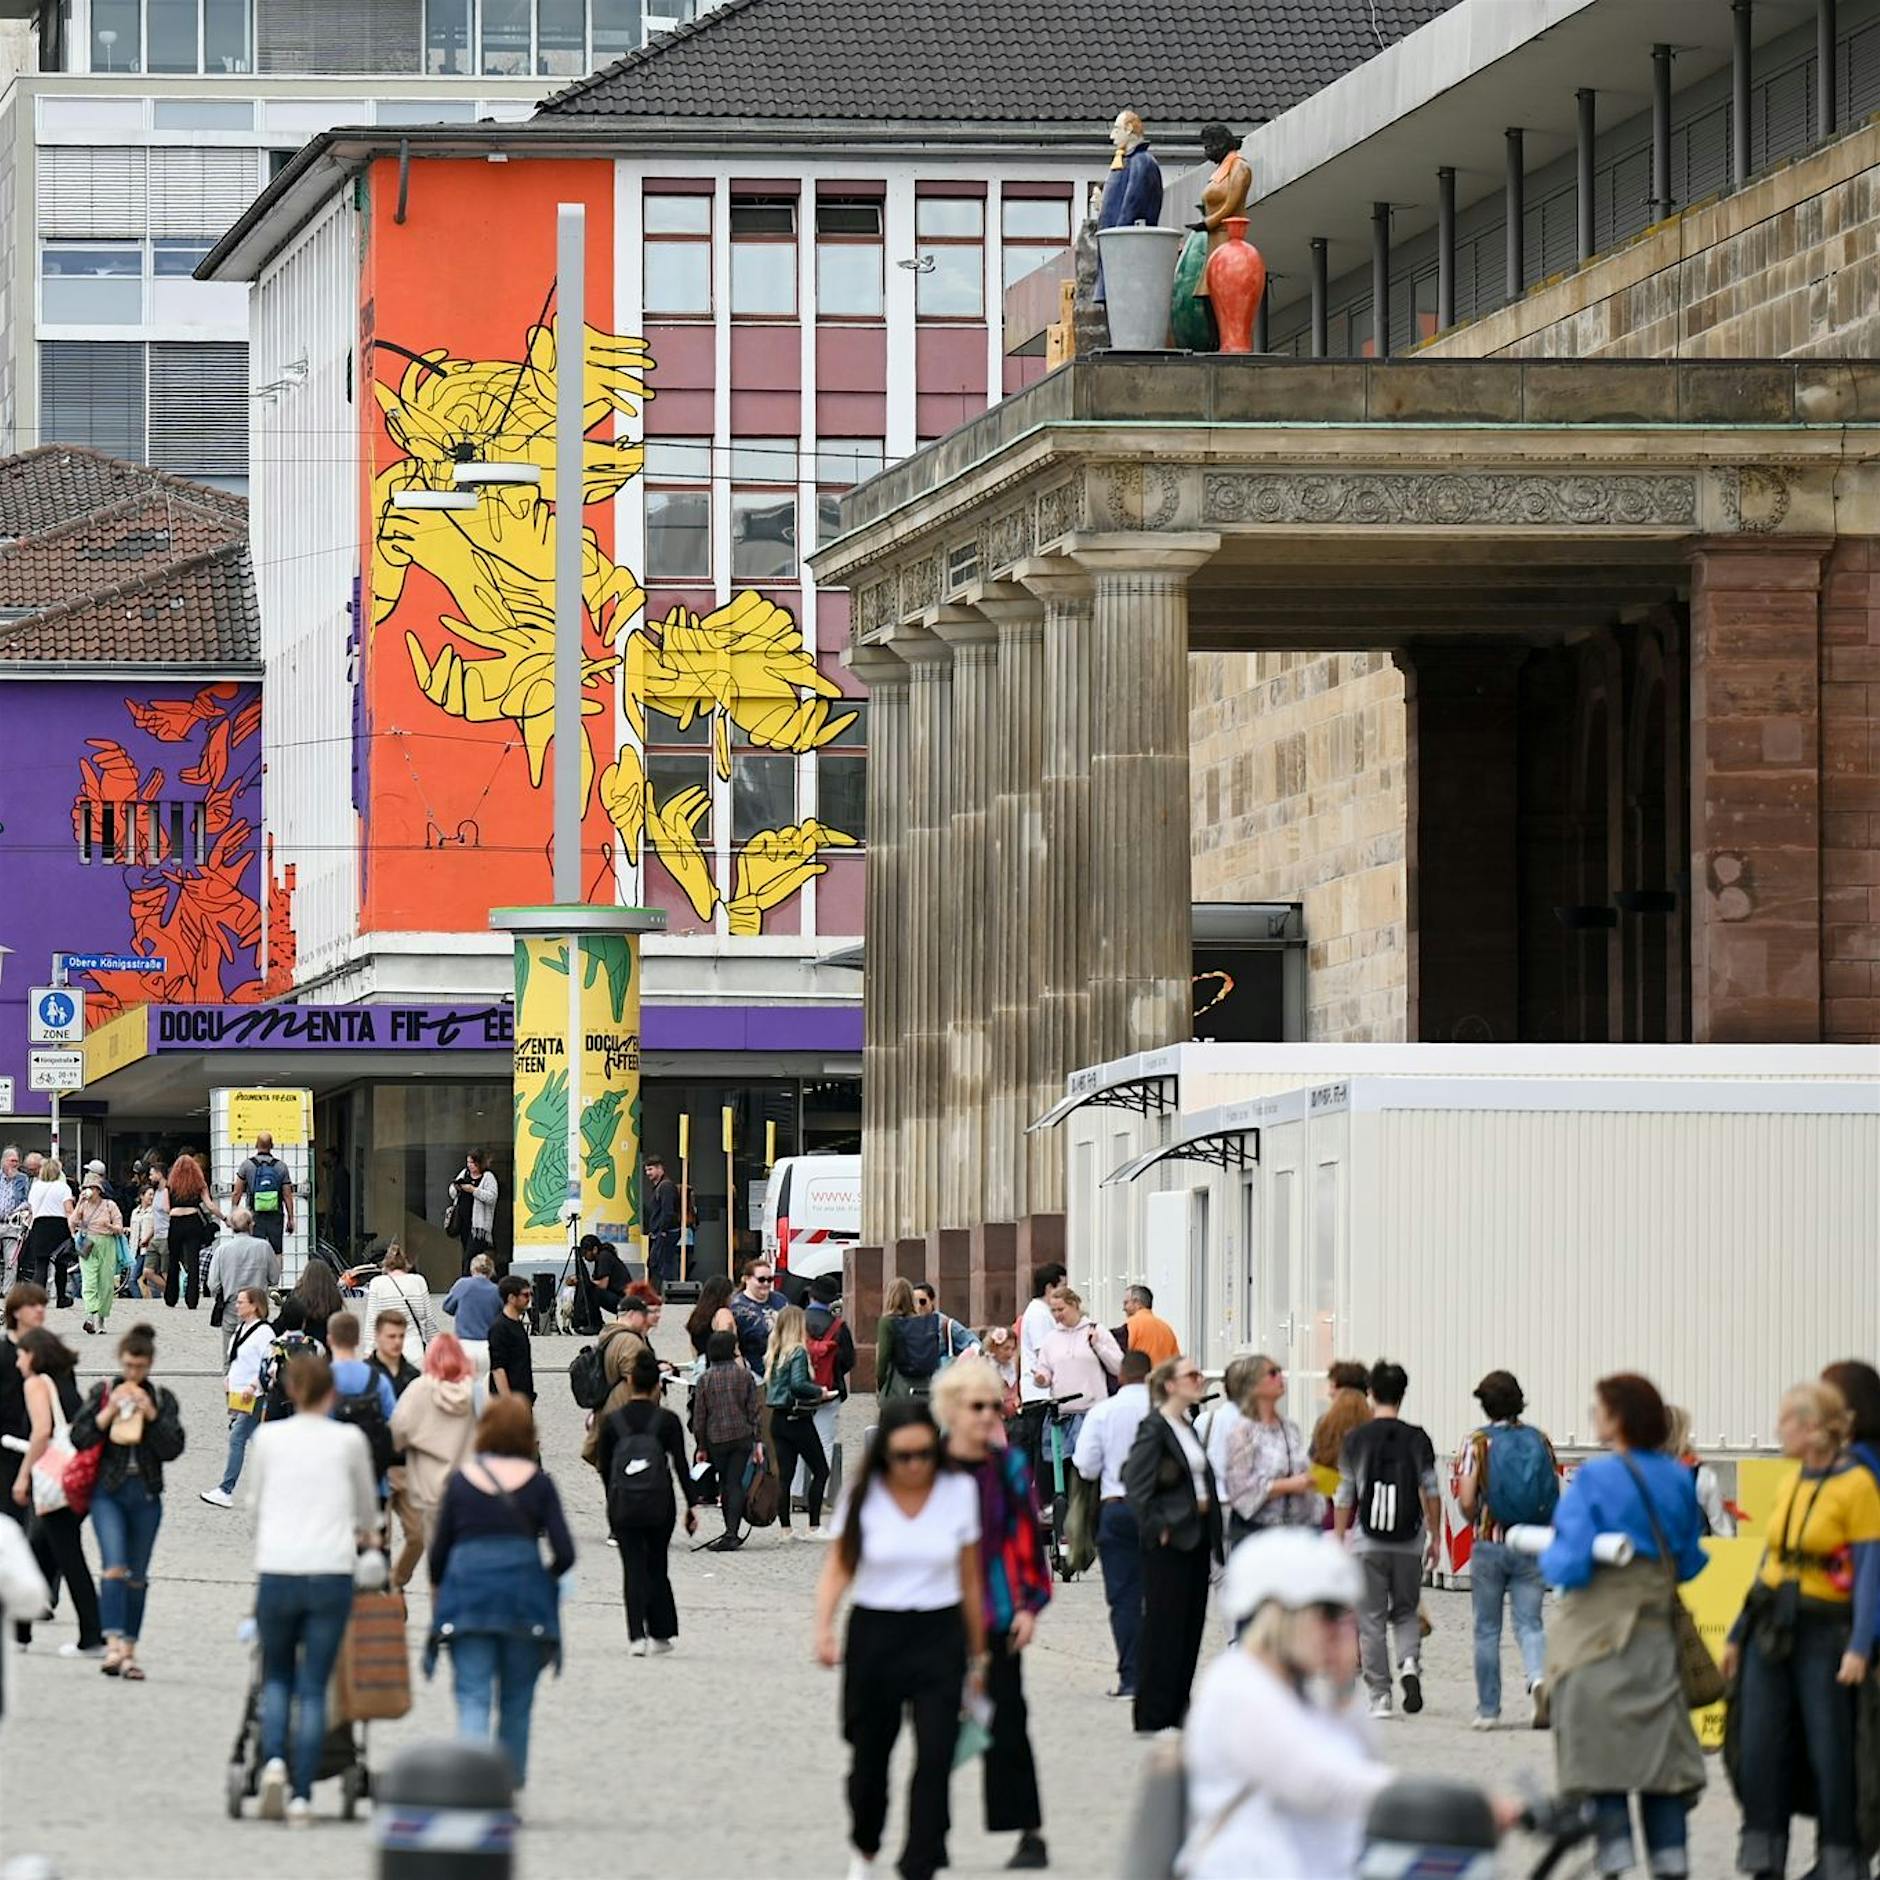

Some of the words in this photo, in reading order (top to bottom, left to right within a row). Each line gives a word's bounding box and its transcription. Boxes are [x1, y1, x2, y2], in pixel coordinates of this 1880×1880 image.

[68, 957, 97, 967] Obere
[99, 957, 162, 970] Königsstraße
[43, 1029, 70, 1039] ZONE
